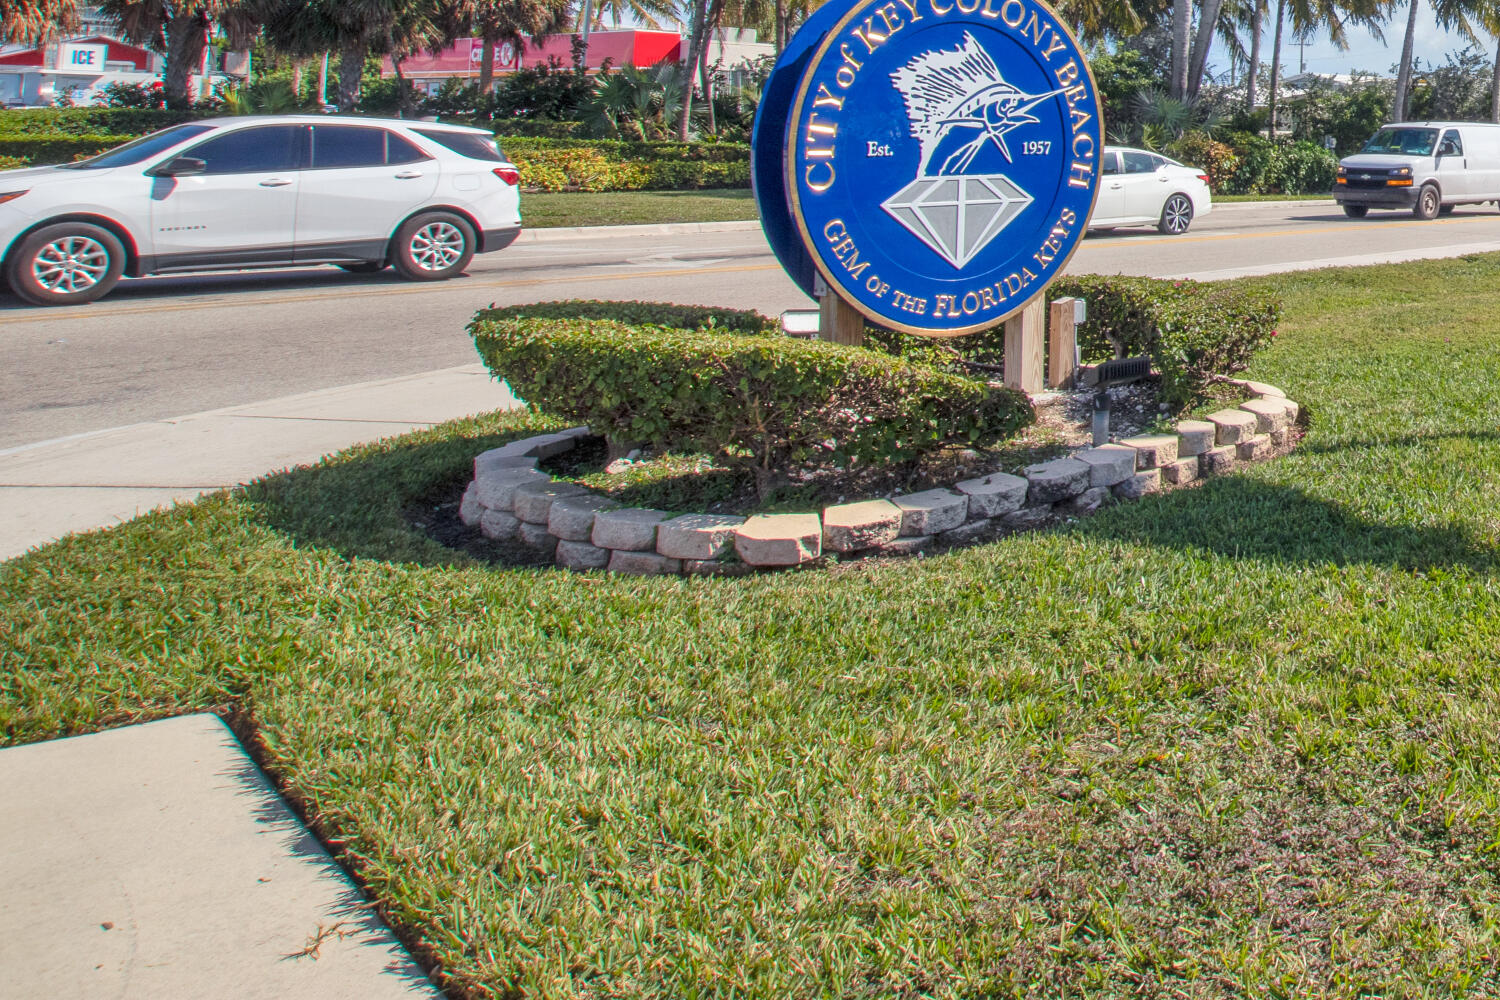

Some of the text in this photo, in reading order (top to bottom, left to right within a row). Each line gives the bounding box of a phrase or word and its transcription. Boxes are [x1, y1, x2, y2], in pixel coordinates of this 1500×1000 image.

[72, 49, 96, 65] ICE
[806, 83, 845, 191] CITY
[836, 43, 864, 88] of
[1054, 57, 1094, 190] BEACH
[867, 141, 1052, 157] Est. 1957
[823, 207, 1077, 318] GEM OF THE FLORIDA KEYS
